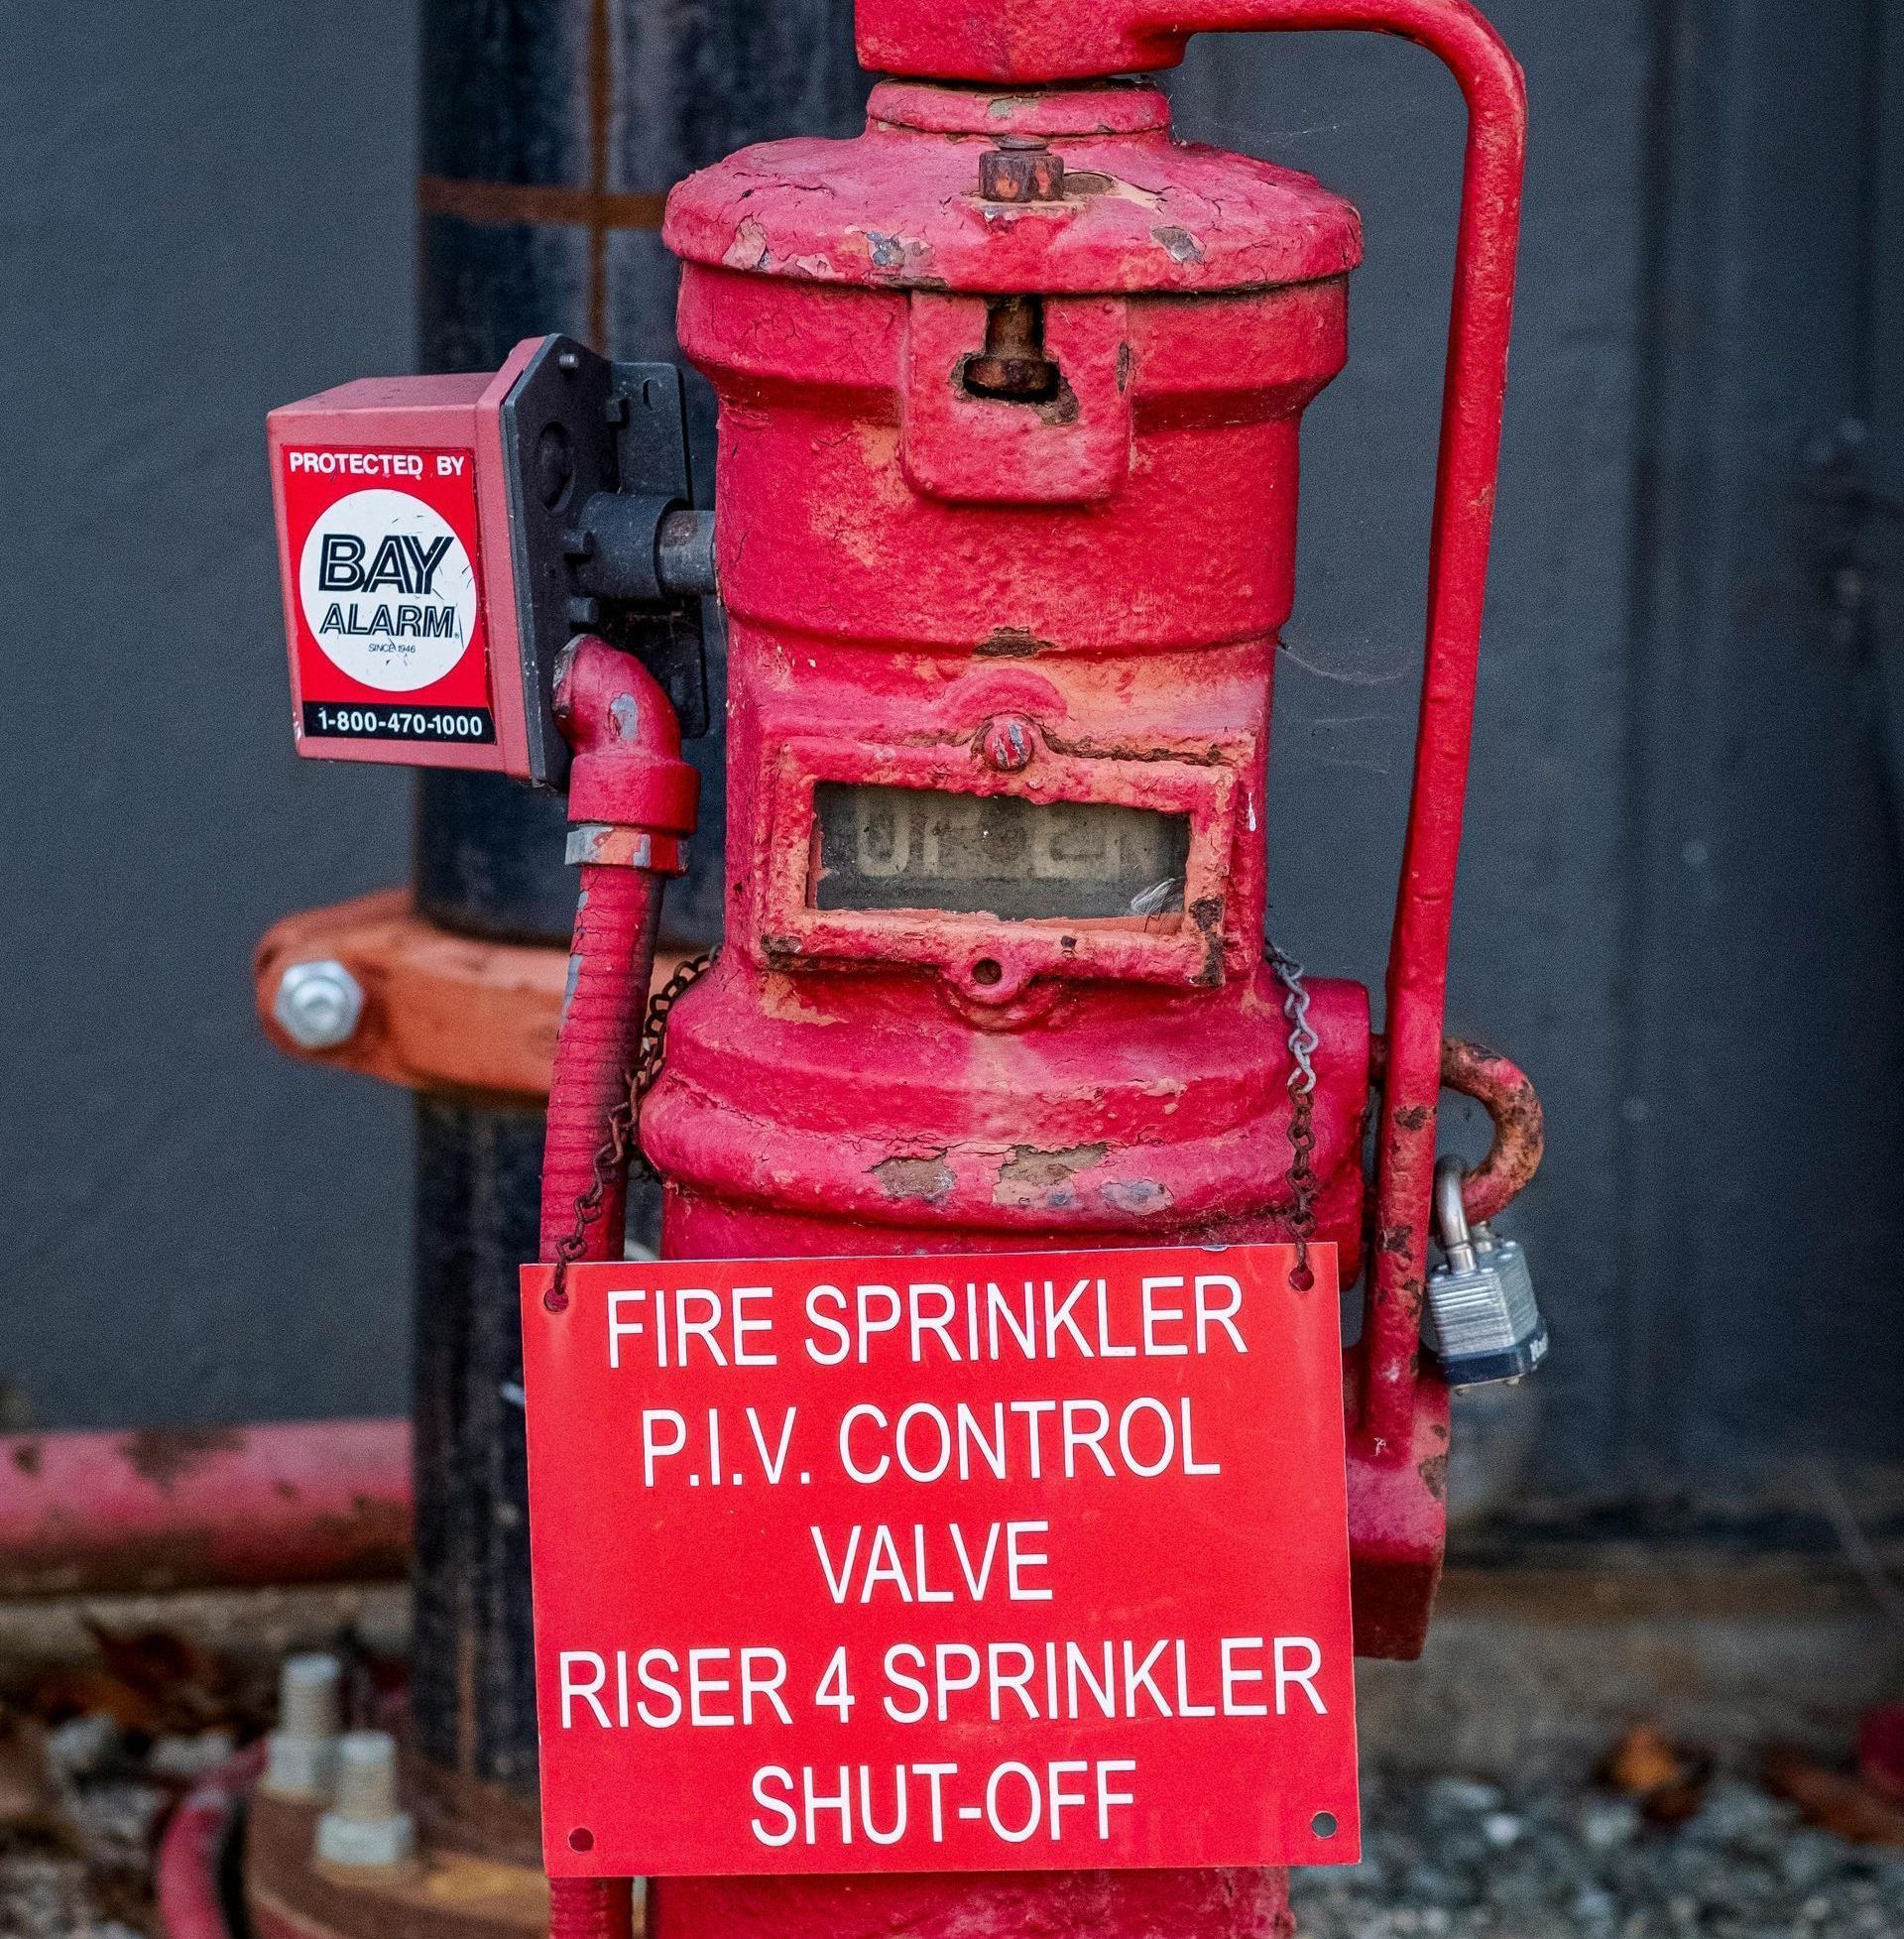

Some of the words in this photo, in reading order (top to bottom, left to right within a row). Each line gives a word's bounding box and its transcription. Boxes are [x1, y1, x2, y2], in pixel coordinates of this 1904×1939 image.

[290, 451, 423, 476] PROTECTED
[436, 454, 465, 477] BY
[317, 533, 454, 595] BAY
[318, 603, 455, 638] ALARM
[368, 643, 395, 653] SINCE
[398, 644, 416, 654] 1946
[317, 709, 483, 736] 1-800-470-1000
[607, 1286, 777, 1369] FIRE
[804, 1274, 1250, 1366] SPRINKLER
[642, 1406, 810, 1488] P.I.V.
[839, 1396, 1221, 1484] CONTROL
[809, 1520, 1053, 1604] VALVE
[559, 1646, 793, 1729] RISER
[814, 1645, 856, 1724] 4
[883, 1636, 1329, 1724] SPRINKLER
[751, 1759, 1136, 1847] SHUT-OFF
